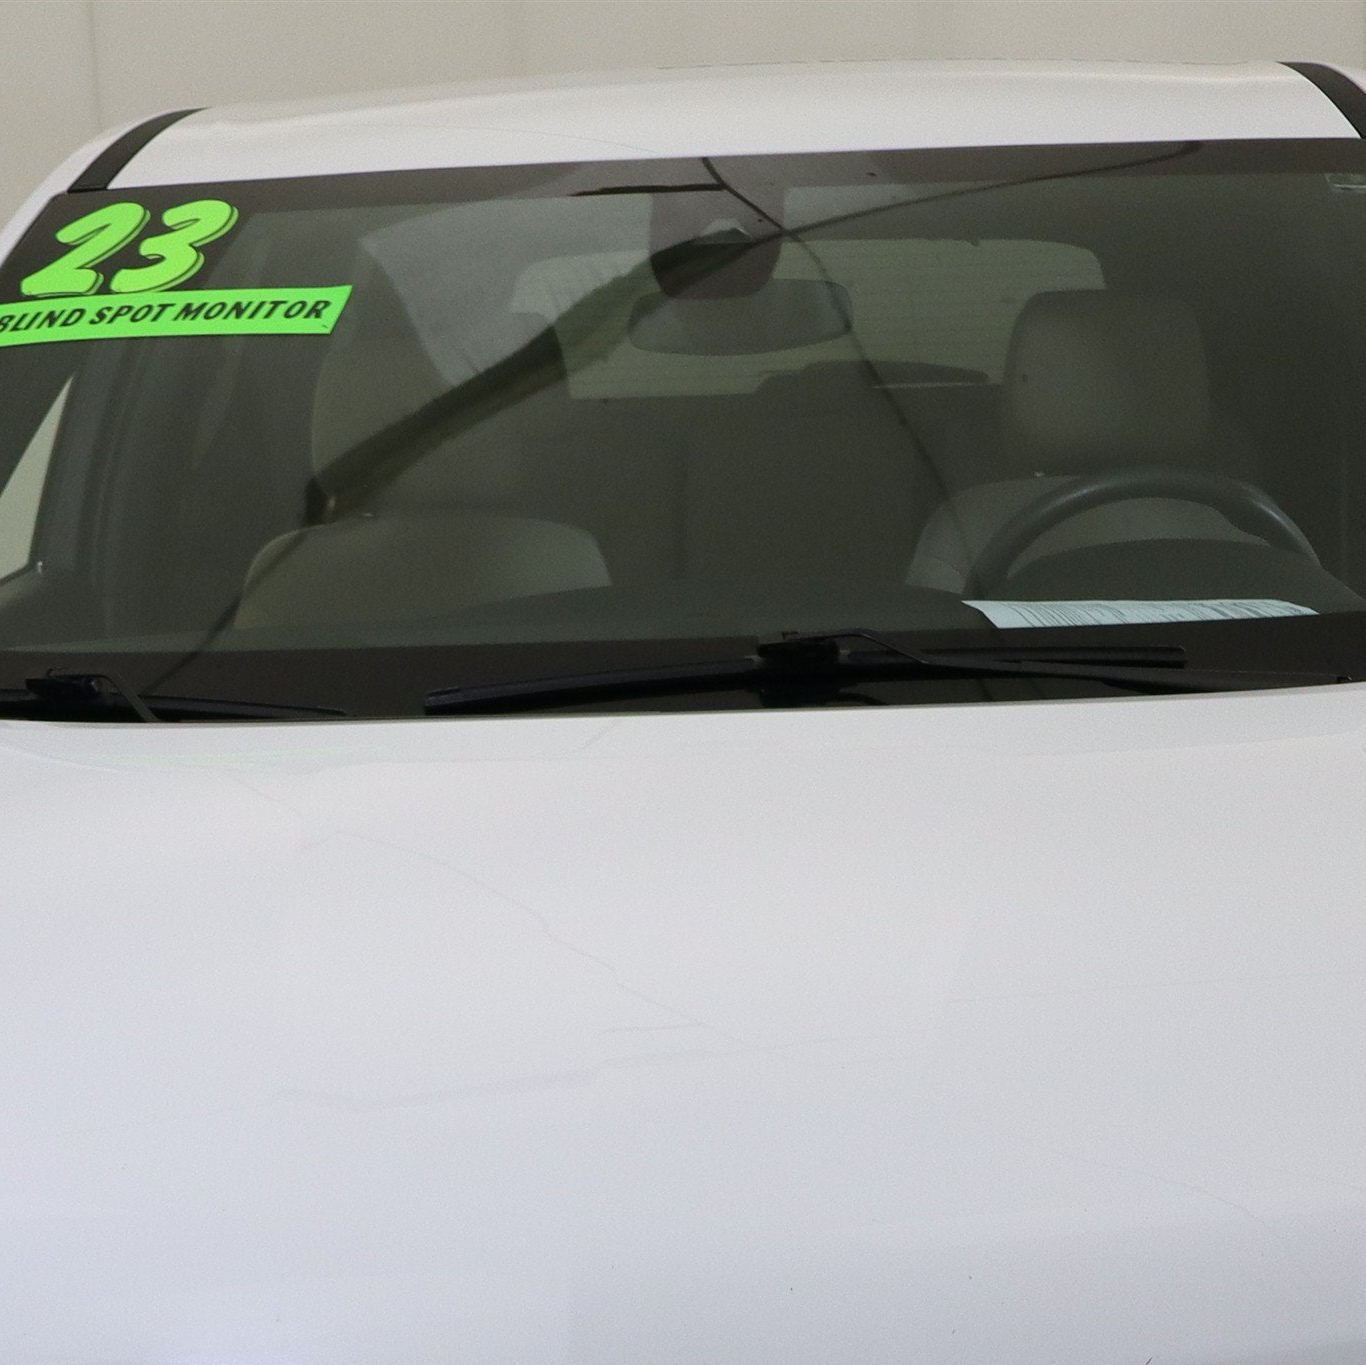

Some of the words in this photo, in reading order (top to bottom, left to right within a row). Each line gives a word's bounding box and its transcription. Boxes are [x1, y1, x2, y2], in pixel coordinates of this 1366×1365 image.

[20, 200, 239, 298] 23
[88, 303, 175, 326] SPOT
[172, 299, 332, 322] MONITOR
